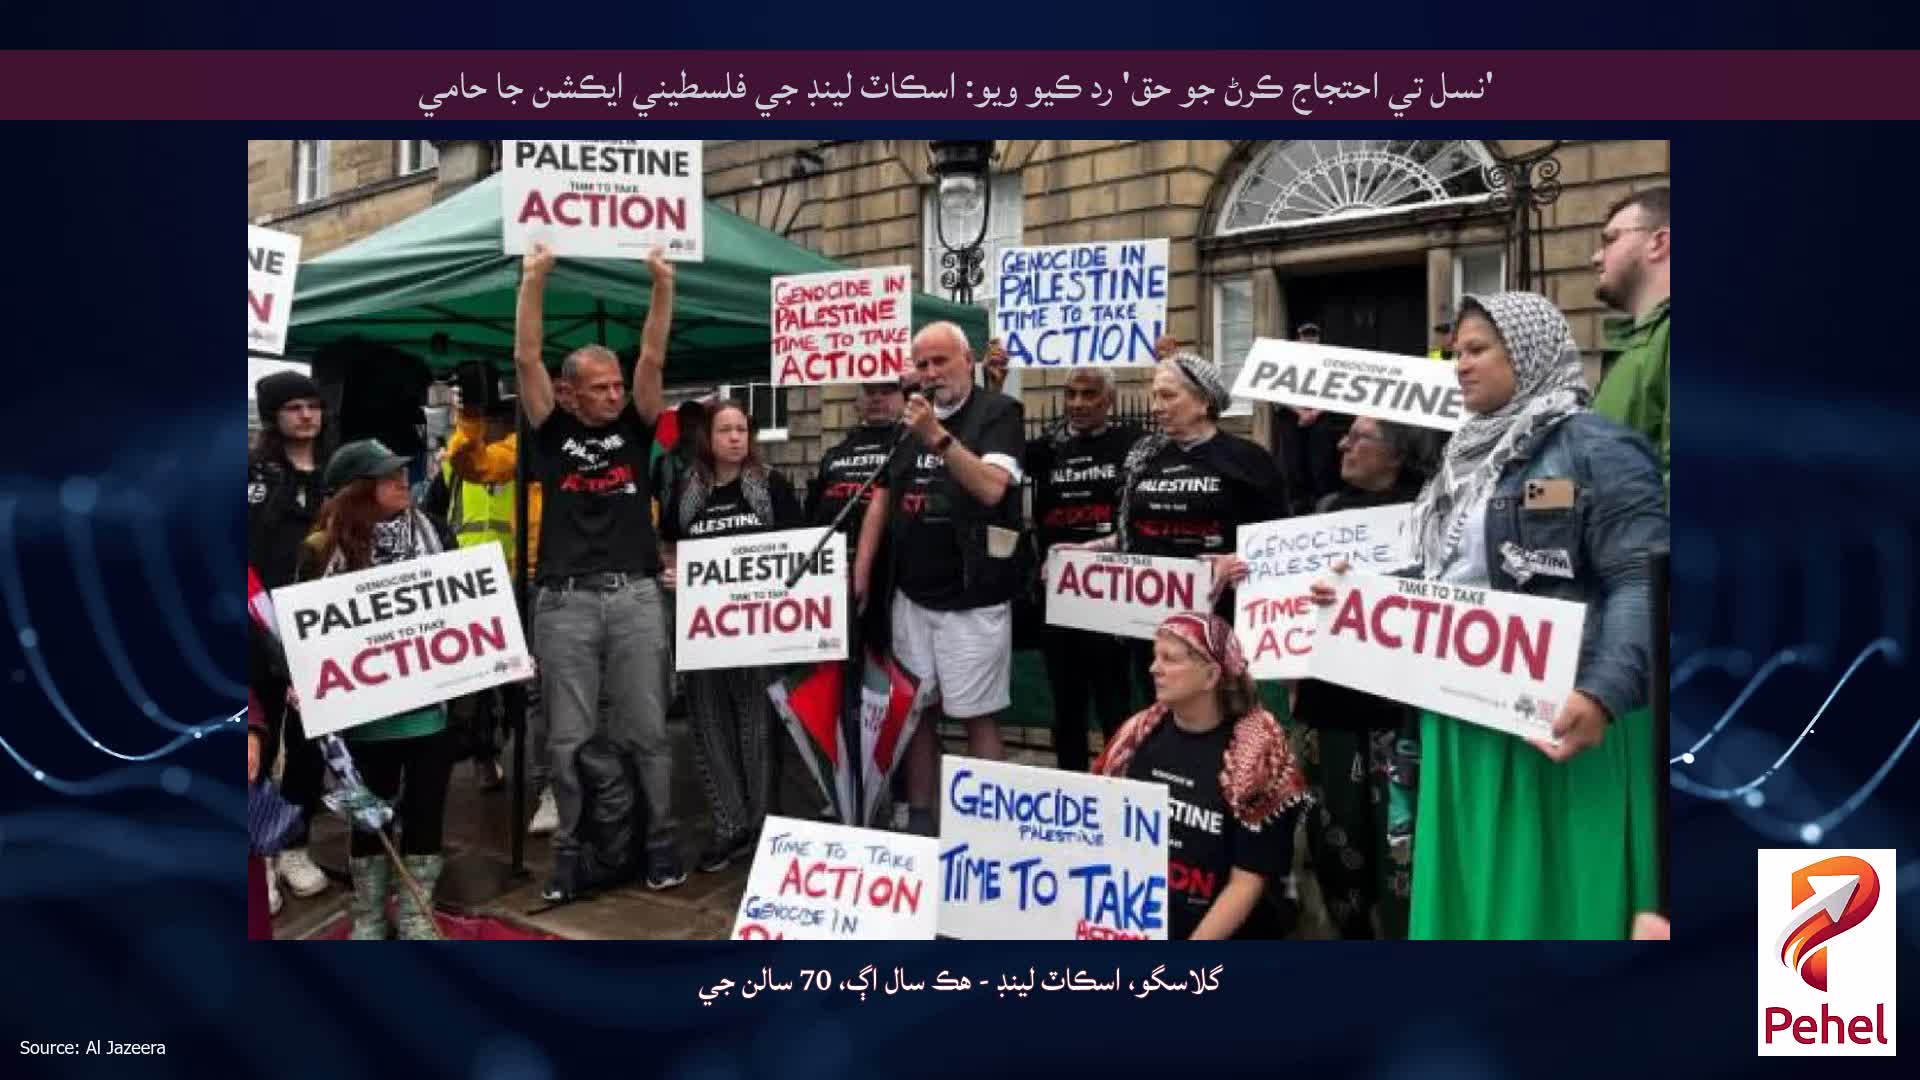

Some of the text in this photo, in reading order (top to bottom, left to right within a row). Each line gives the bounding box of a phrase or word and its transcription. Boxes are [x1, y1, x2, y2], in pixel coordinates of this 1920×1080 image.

[516, 141, 689, 177] PALESTINE
[518, 189, 687, 231] ACTION
[1002, 244, 1145, 274] GENOCIDE IN
[775, 274, 905, 306] GENOCIDE IN
[1000, 265, 1166, 308] PALESTINE
[775, 299, 896, 334] PALESTINE
[998, 302, 1136, 331] TIME TO TAKE
[773, 328, 909, 360] TIME TO TAKE
[1006, 320, 1162, 365] ACTION
[780, 348, 905, 384] ACTION
[1250, 360, 1463, 419] PALESTINE
[1247, 524, 1368, 559] GENOCIDE
[294, 567, 497, 641] PALESTINE
[1056, 561, 1194, 611] ACTION
[1396, 580, 1487, 606] TIME TO TAKE
[688, 596, 832, 640] ACTION
[1242, 596, 1312, 629] TIME
[1330, 588, 1553, 681] ACTION
[315, 616, 507, 700] ACTION
[825, 842, 848, 859] TO
[863, 844, 914, 872] TAKE
[1009, 857, 1058, 912] TO
[1068, 863, 1166, 931] TAKE
[832, 907, 859, 935] IN
